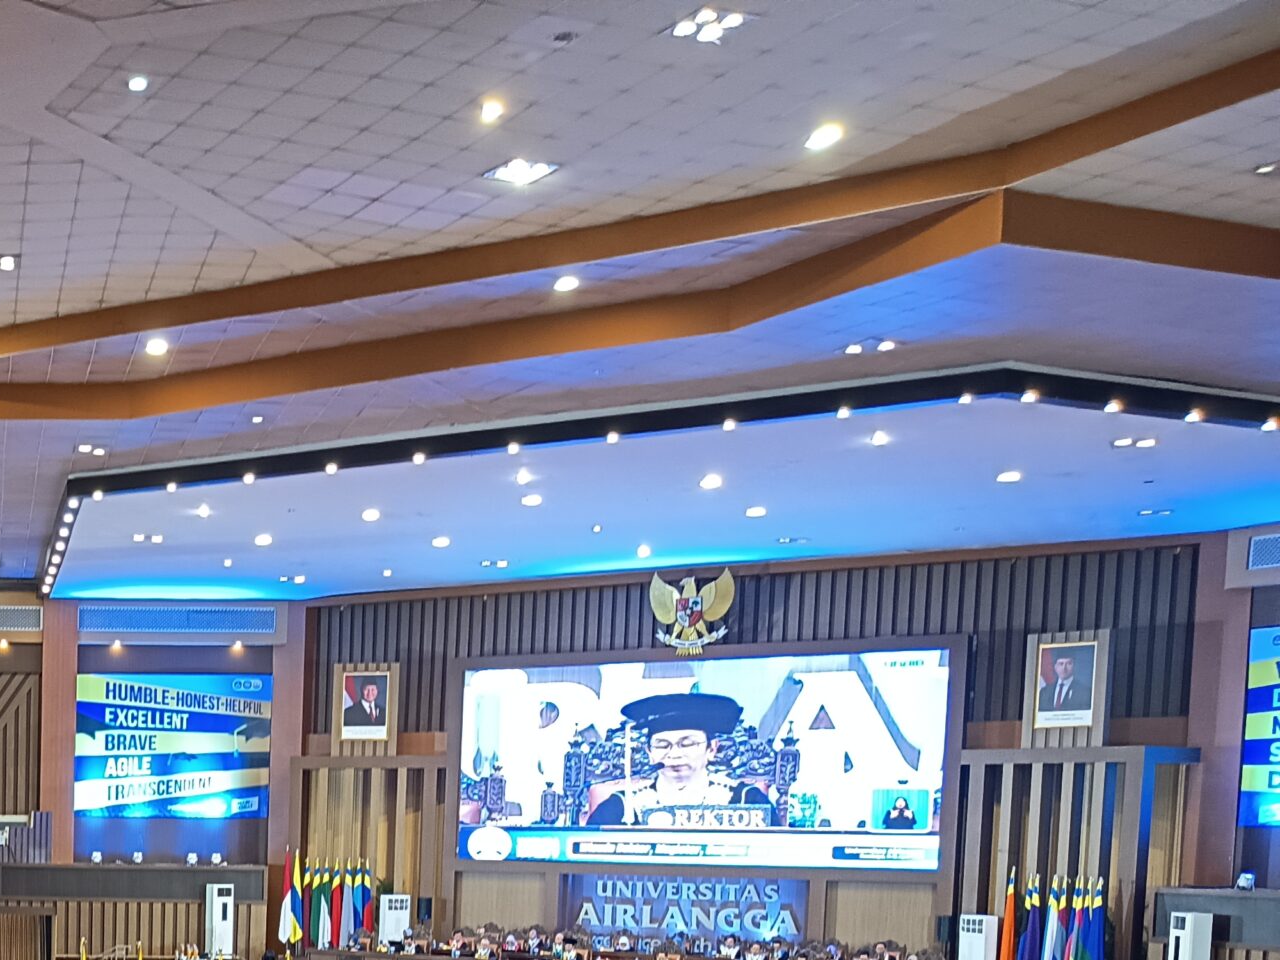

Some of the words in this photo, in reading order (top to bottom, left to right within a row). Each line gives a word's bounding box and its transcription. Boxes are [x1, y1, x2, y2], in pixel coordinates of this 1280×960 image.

[105, 708, 189, 730] EXCELLENT
[105, 733, 157, 751] BRAVE
[104, 756, 151, 778] AGILE
[674, 809, 767, 828] REKTOR
[596, 879, 780, 902] UNIVERSITAS
[576, 902, 800, 936] AIRLANGGA
